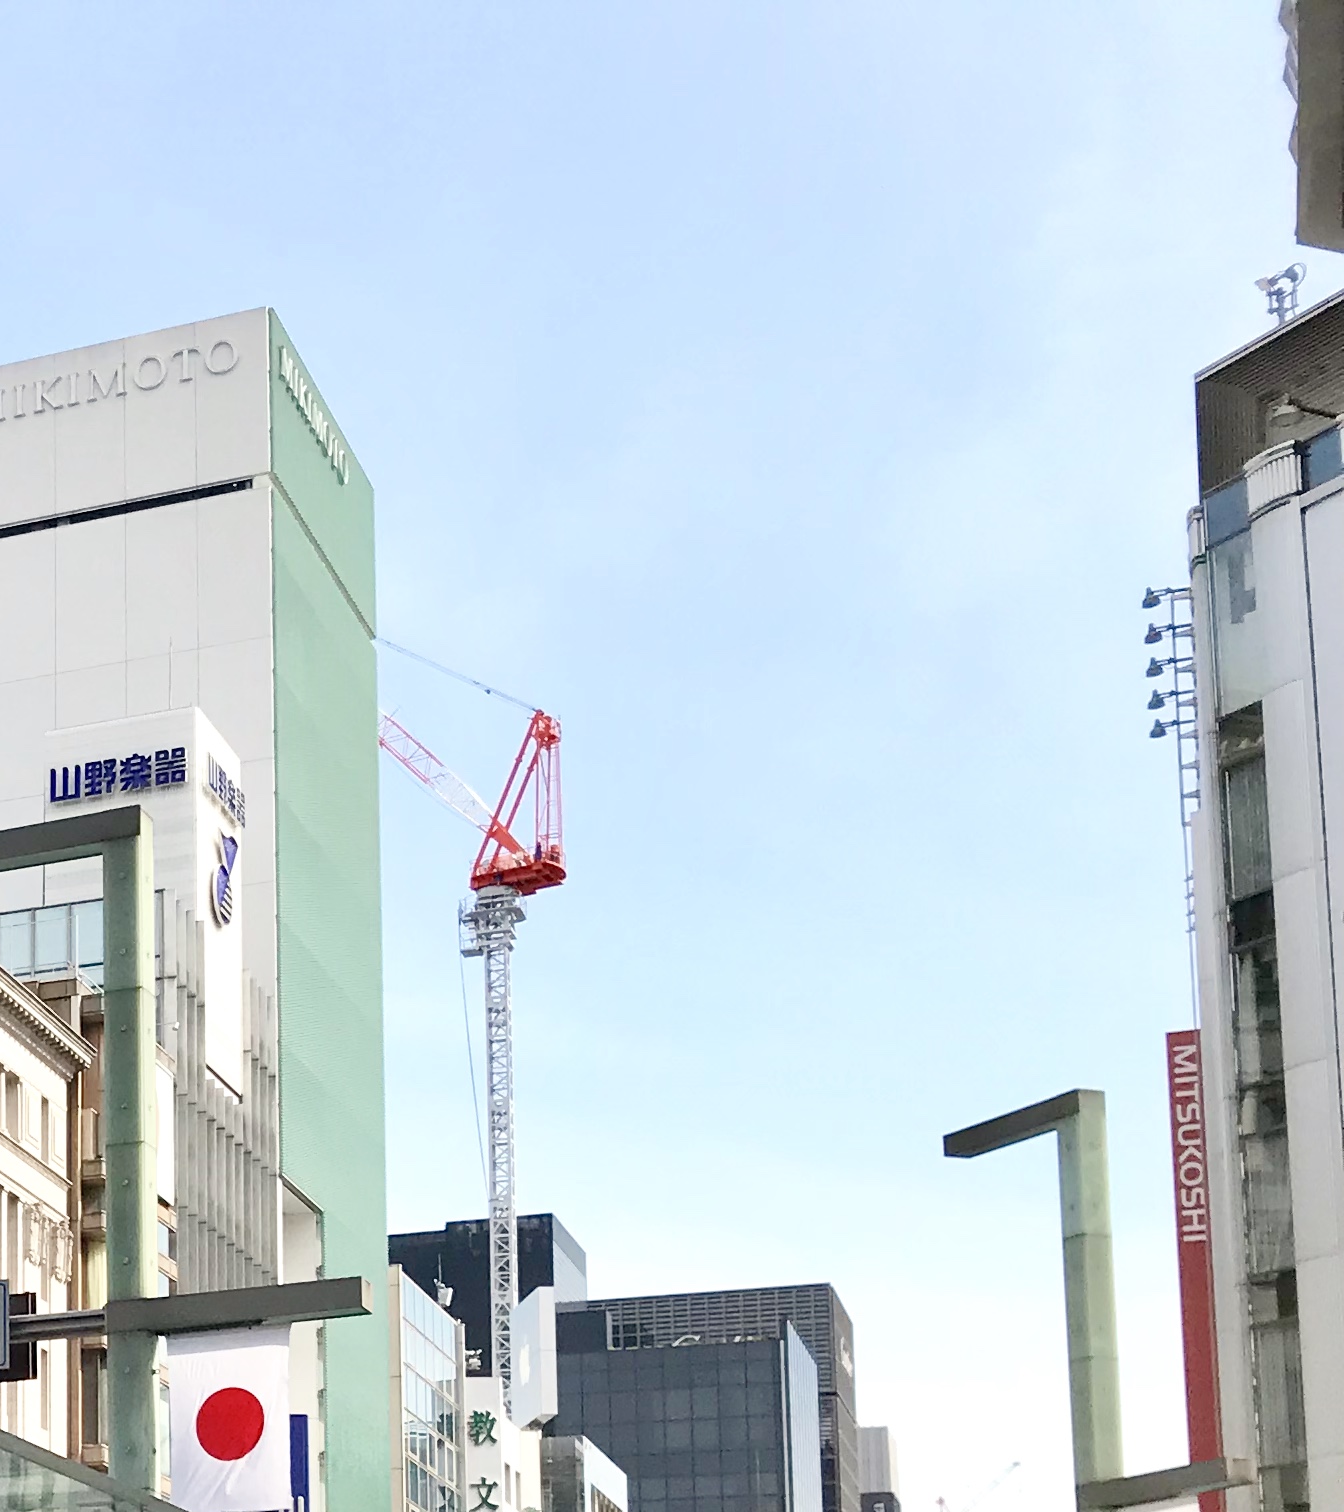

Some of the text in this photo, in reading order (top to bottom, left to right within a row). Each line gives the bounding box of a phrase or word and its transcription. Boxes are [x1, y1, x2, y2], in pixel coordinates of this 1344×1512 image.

[279, 346, 351, 486] MIKIMOTO
[49, 746, 188, 803] 山野楽器
[208, 751, 247, 829] 山野楽器
[1171, 1043, 1207, 1245] MITSUKOSHI
